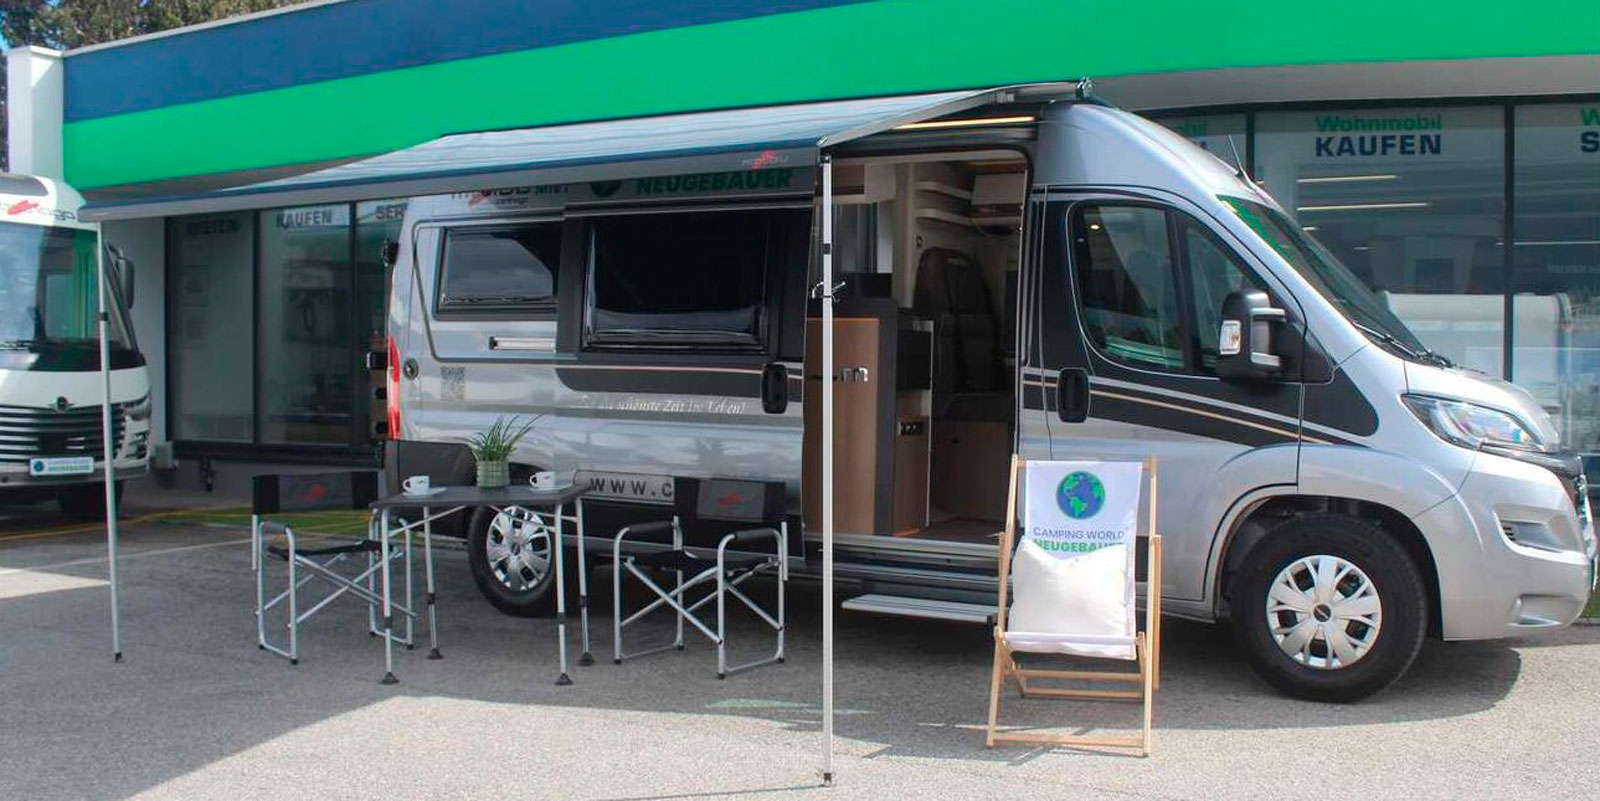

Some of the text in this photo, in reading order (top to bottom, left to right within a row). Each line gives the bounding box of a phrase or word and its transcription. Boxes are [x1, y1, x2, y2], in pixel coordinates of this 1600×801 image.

[1316, 113, 1442, 131] Wohnmobil
[1315, 135, 1442, 157] KAUFEN
[636, 167, 795, 195] NEUGEBAUER
[276, 209, 333, 228] KAUFEN
[1033, 527, 1124, 541] CAMPING WORLD
